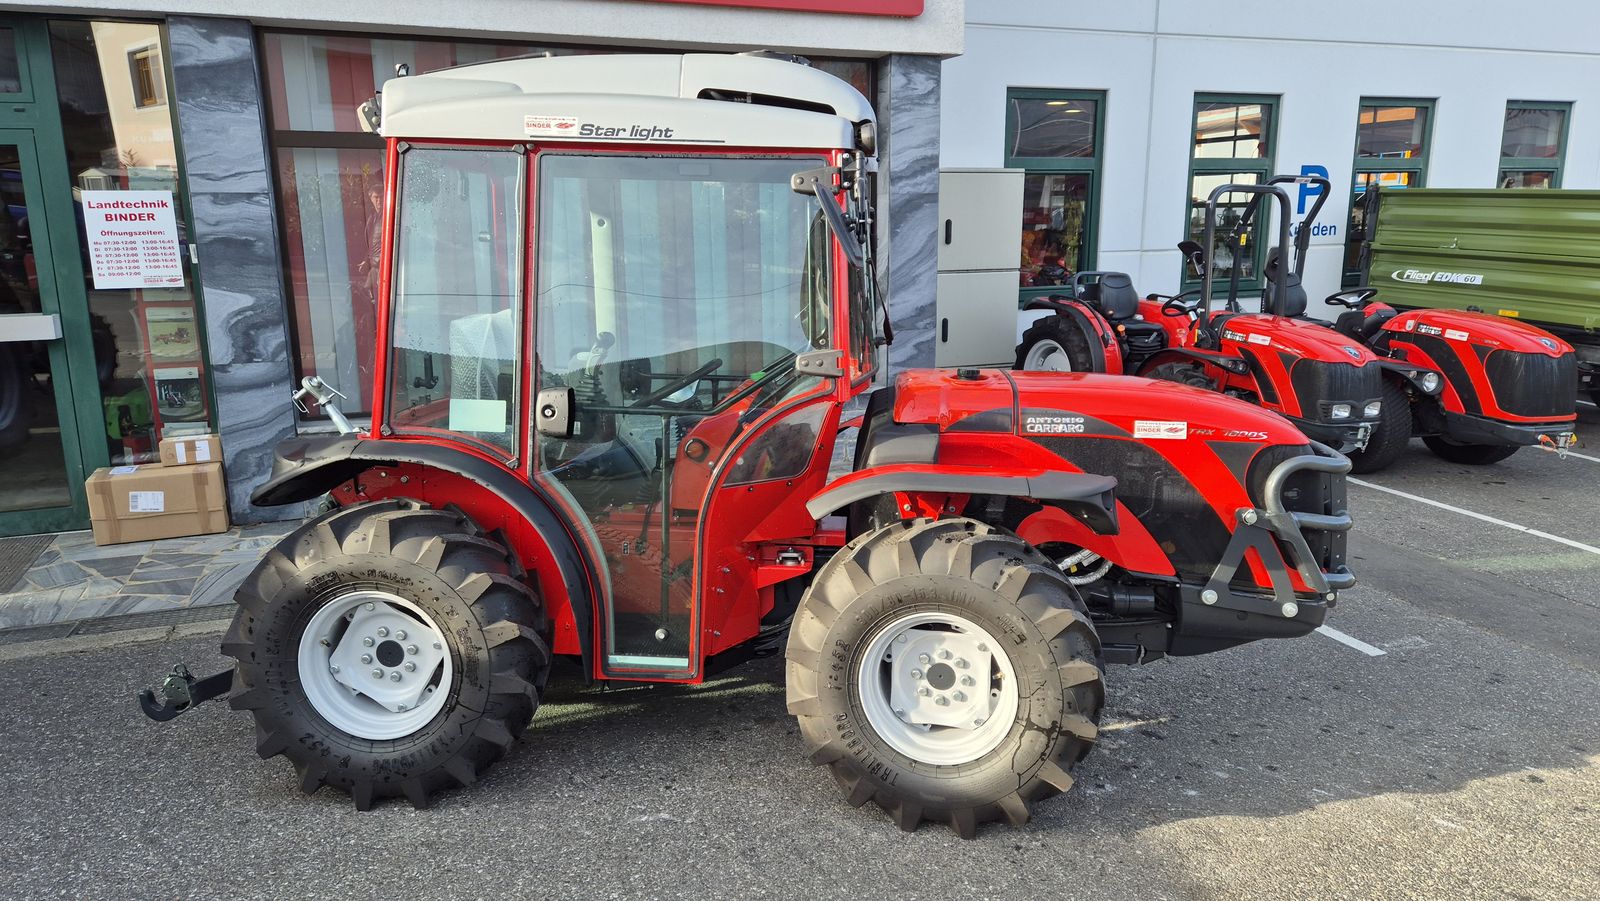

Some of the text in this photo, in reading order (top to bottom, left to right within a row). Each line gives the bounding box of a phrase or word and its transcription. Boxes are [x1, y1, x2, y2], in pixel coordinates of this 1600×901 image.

[579, 123, 674, 140] Star light
[1297, 165, 1329, 214] P
[88, 200, 169, 209] Landtechnik
[104, 213, 156, 222] BINDER
[100, 229, 166, 237] Öffnungszeiten:
[1463, 275, 1477, 283] 60
[1026, 423, 1085, 433] CARRARO
